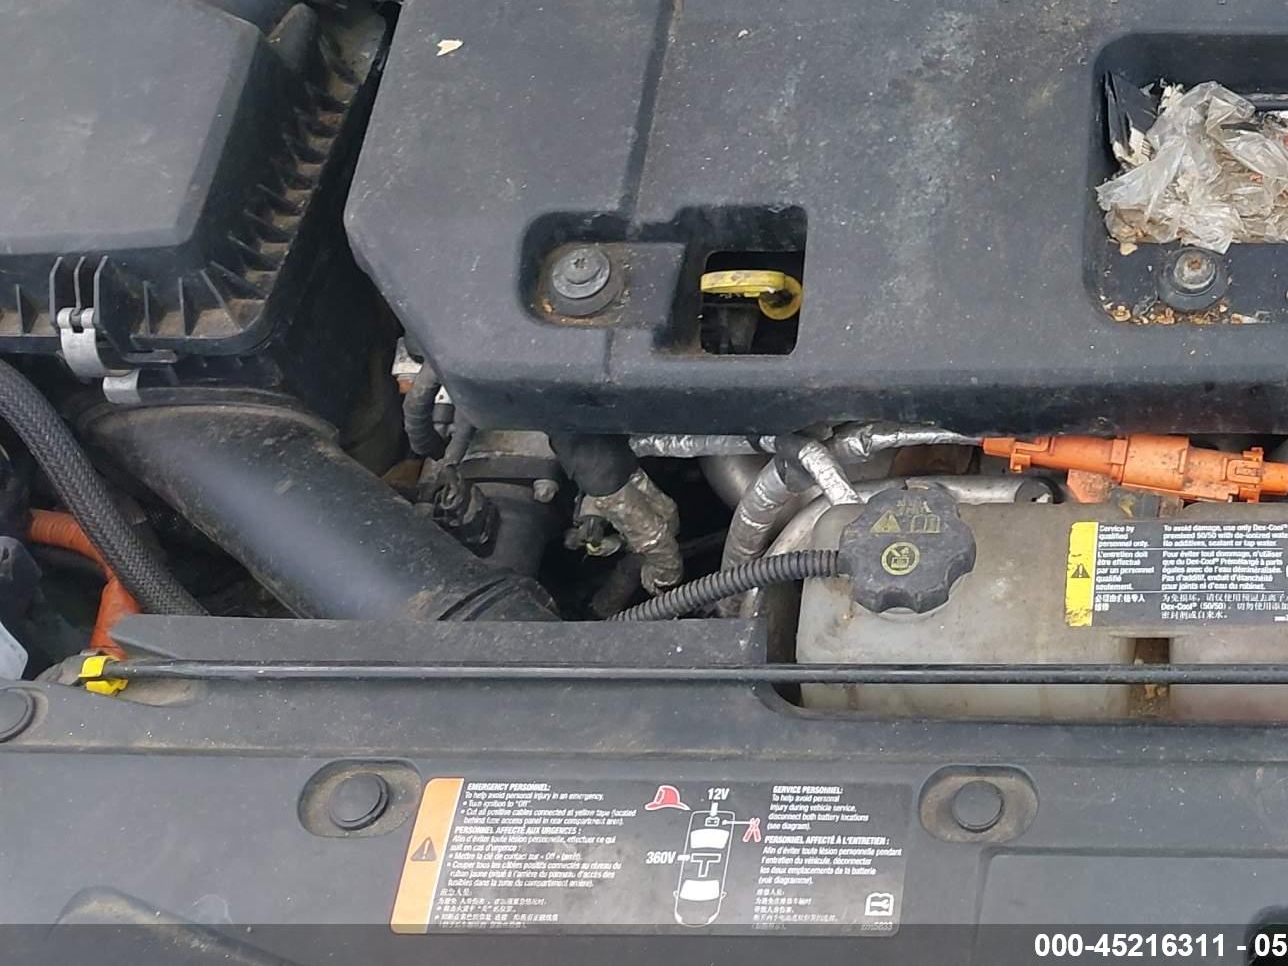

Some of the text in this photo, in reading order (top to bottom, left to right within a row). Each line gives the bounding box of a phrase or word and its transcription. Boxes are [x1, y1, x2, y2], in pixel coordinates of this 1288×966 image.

[1237, 524, 1252, 532] only
[1243, 540, 1255, 548] tap
[467, 783, 508, 791] EMERGENCY
[773, 786, 843, 794] SERVICE PERSONNEL:
[473, 792, 487, 800] help
[534, 793, 551, 801] injury
[707, 788, 730, 800] 12V
[780, 794, 794, 803] help
[813, 795, 840, 803] personal
[770, 804, 788, 812] injury
[789, 804, 809, 813] during
[810, 804, 832, 812] vehicle
[524, 818, 542, 826] panel
[817, 814, 840, 822] battery
[840, 814, 869, 822] locations
[764, 836, 804, 844] PERSONNEL
[801, 847, 818, 855] toute
[875, 848, 902, 856] pendant
[645, 852, 676, 864] 360V
